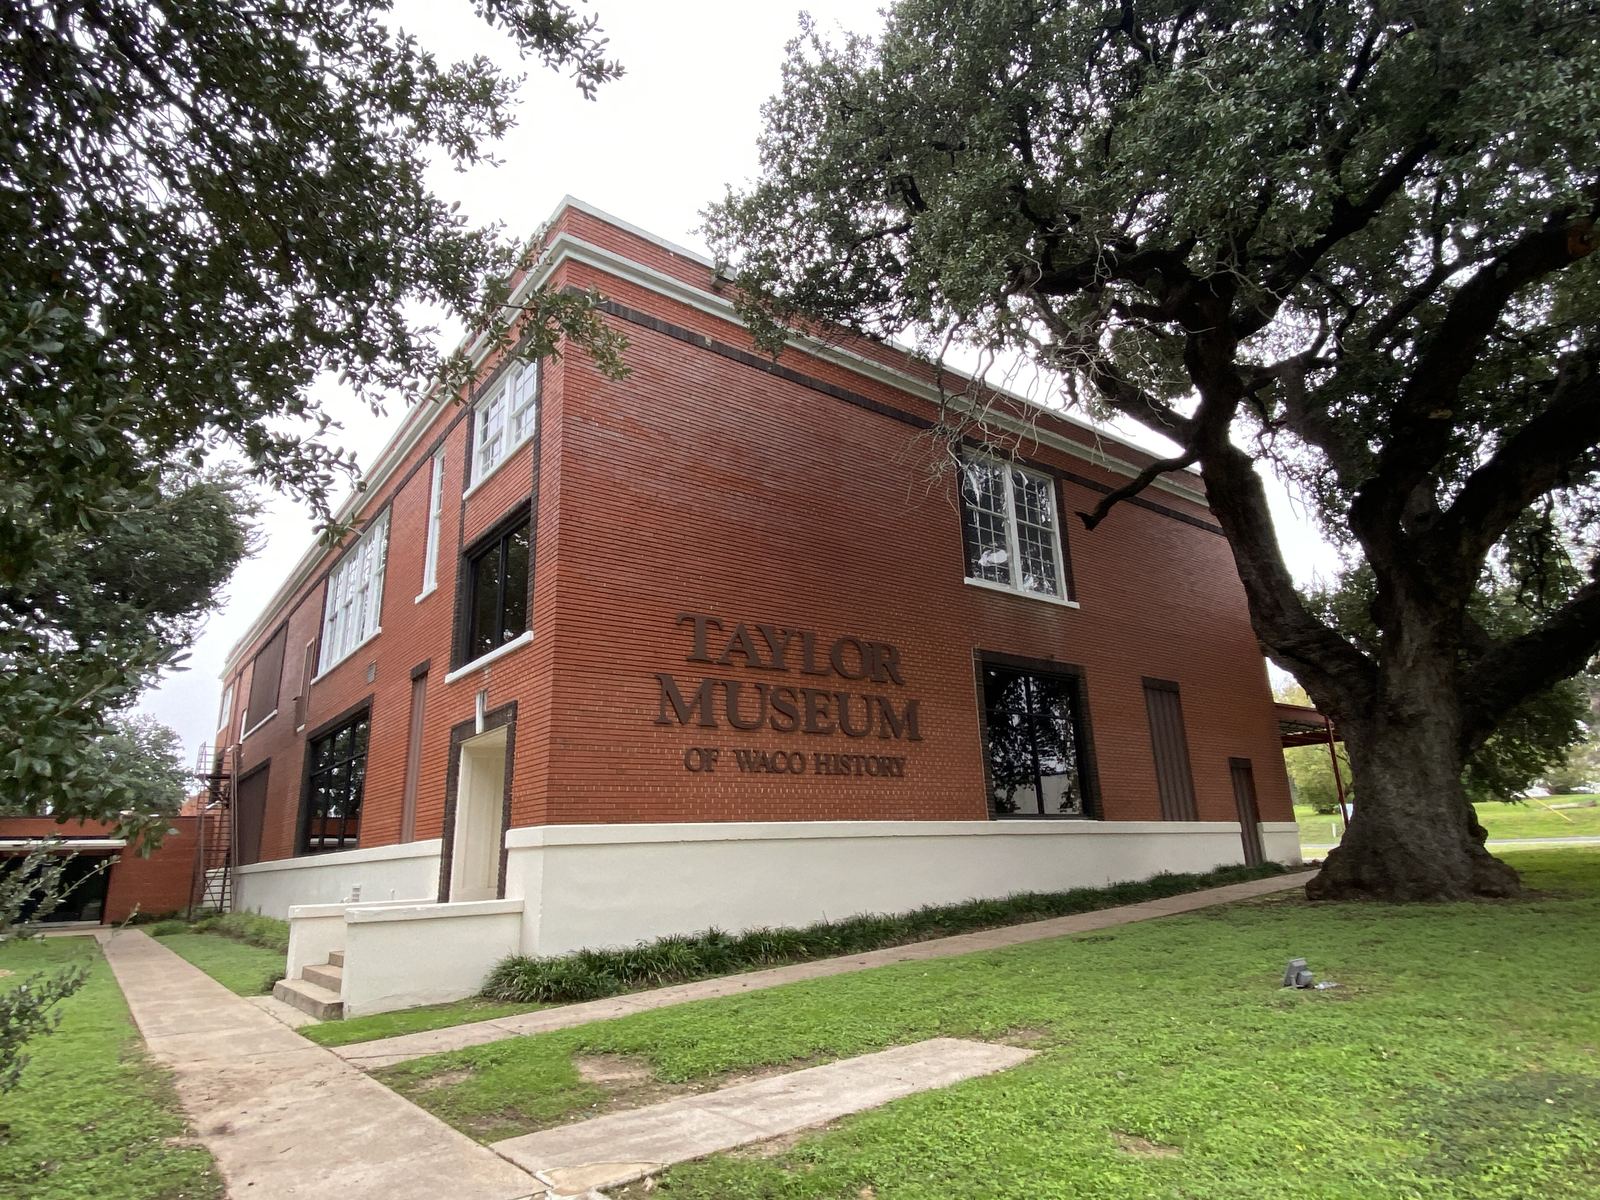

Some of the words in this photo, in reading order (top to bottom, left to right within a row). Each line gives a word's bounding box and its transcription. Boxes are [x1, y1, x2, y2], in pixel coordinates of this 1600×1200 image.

[677, 612, 905, 685] TAYLOR
[654, 673, 923, 741] MUSEUM
[684, 747, 720, 772] OF
[733, 749, 806, 774] WACO
[815, 752, 906, 777] HISTORY
